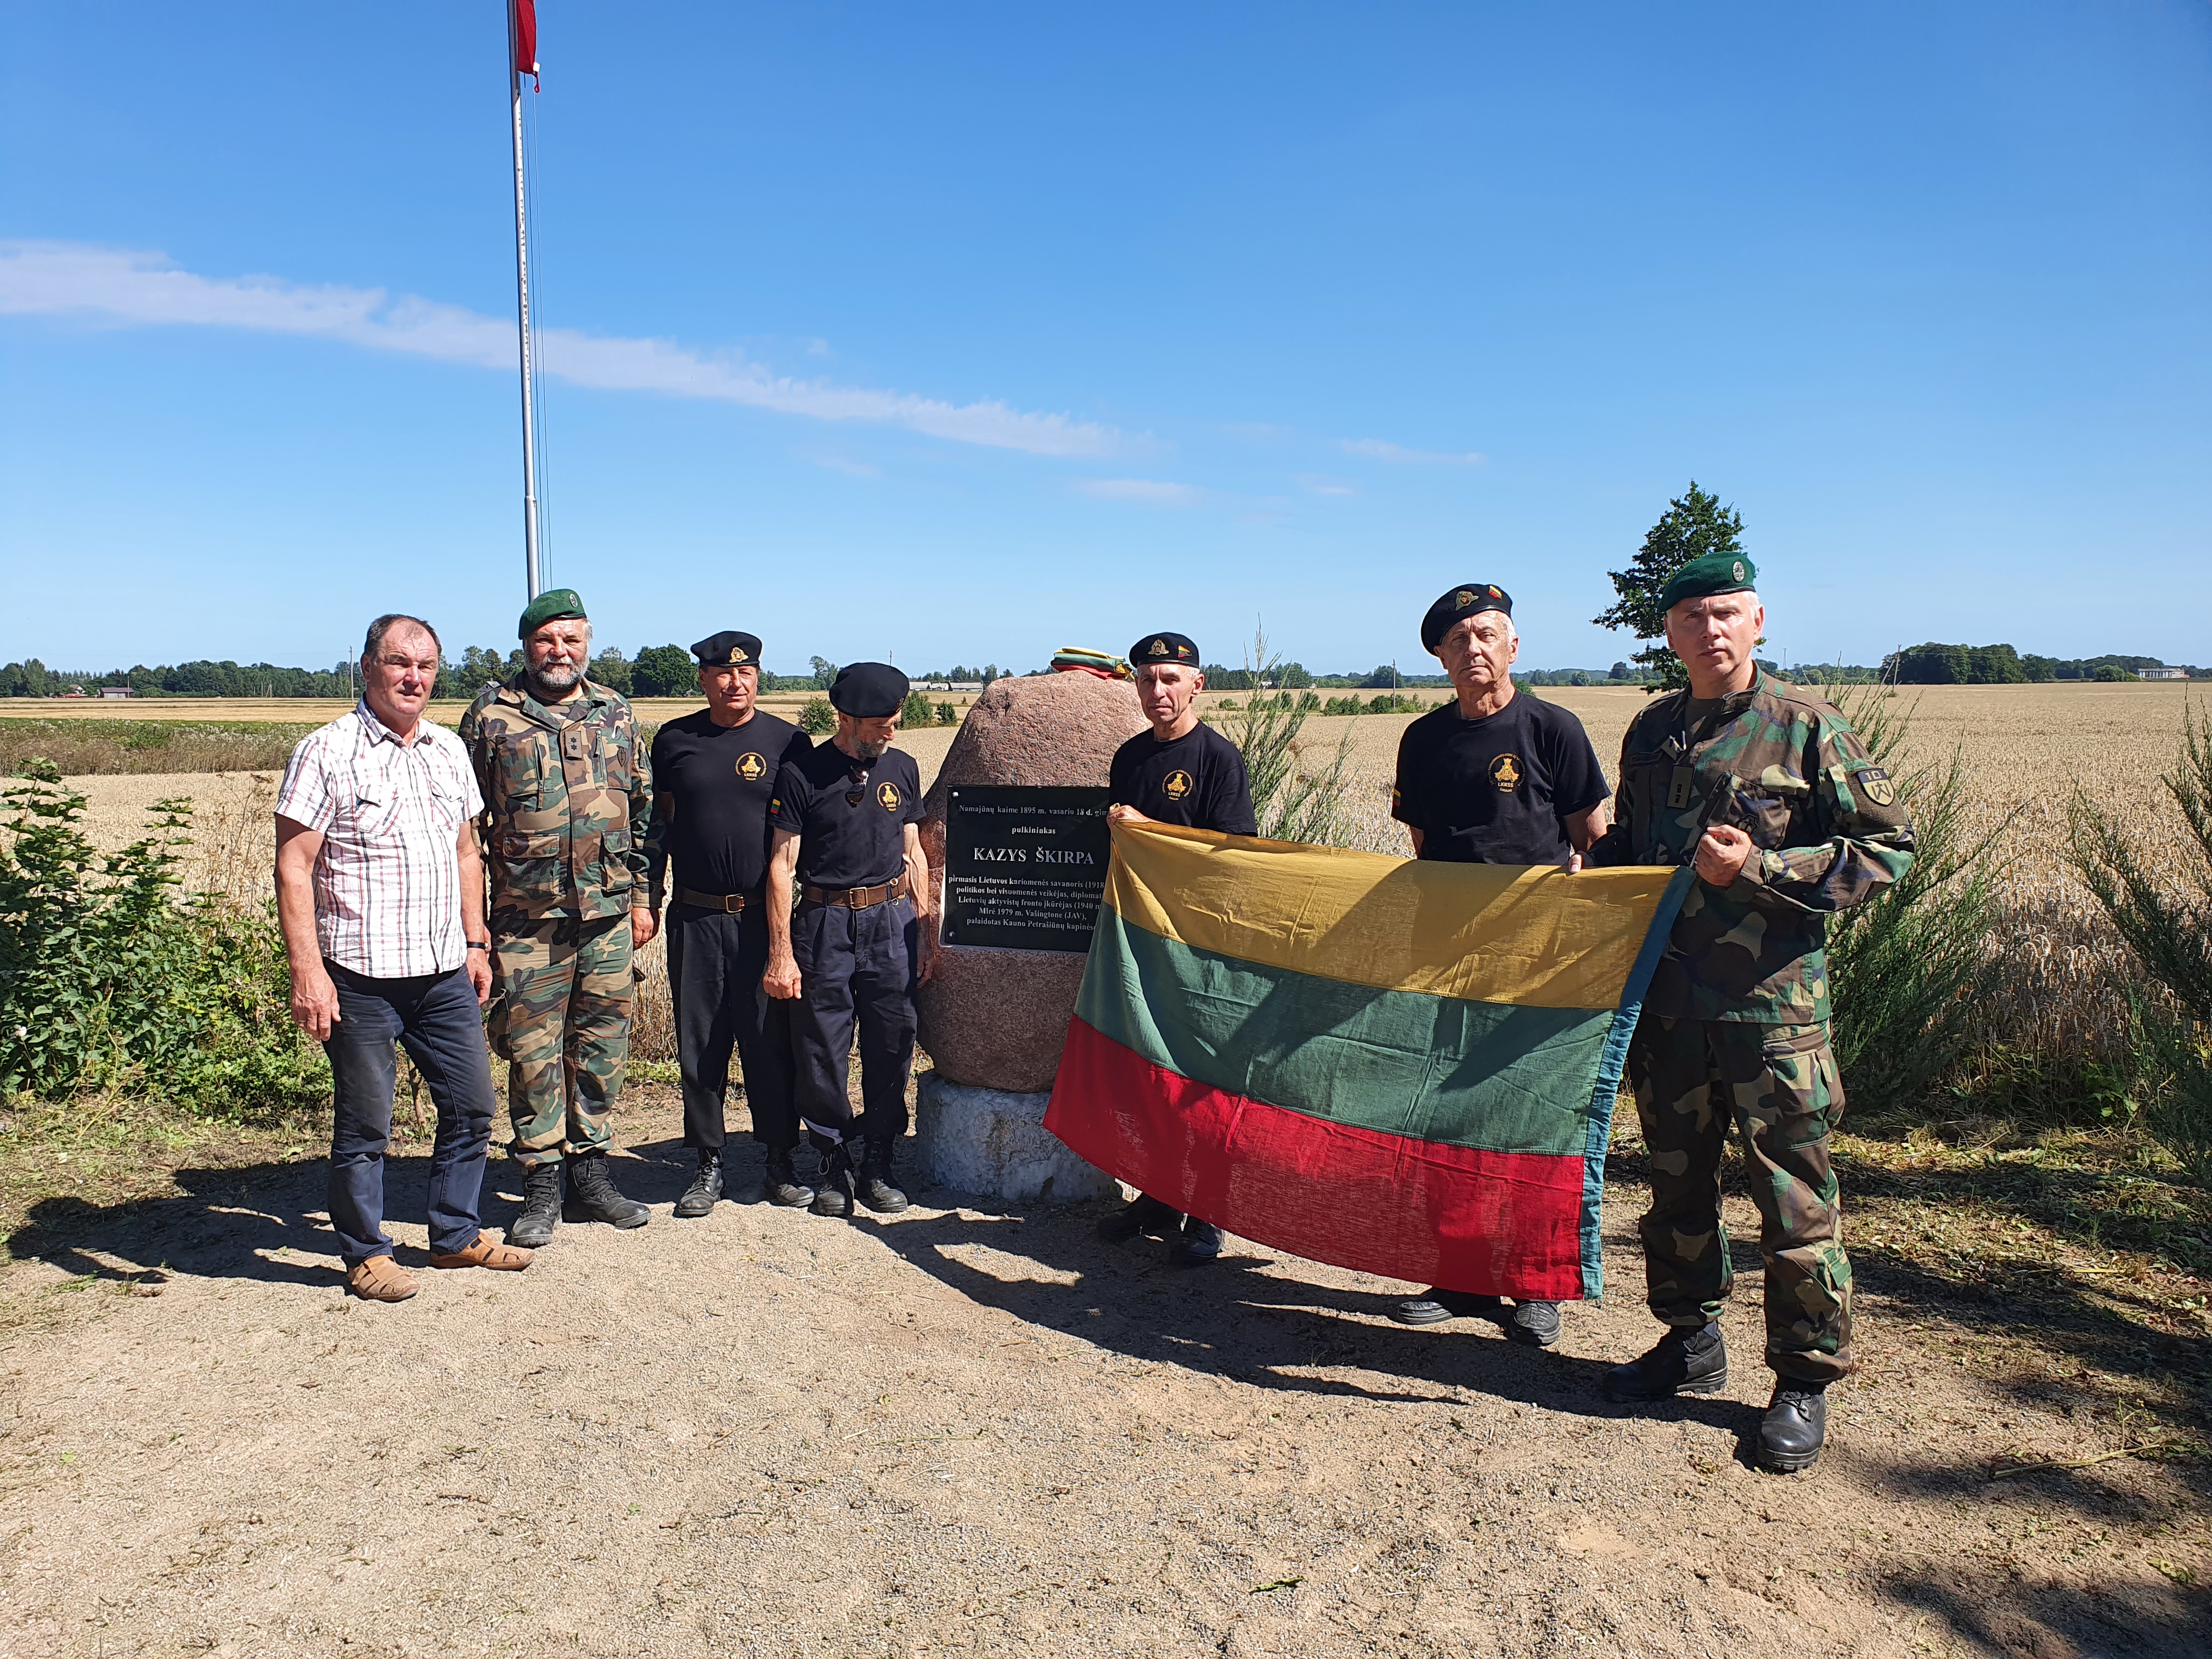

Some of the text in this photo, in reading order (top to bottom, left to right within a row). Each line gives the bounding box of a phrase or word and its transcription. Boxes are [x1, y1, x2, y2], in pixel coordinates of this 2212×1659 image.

[1865, 770, 1882, 780] 10
[959, 804, 995, 815] Namajūnų
[997, 805, 1018, 814] kaime
[1094, 809, 1108, 817] gim
[1012, 826, 1056, 834] pulkininkas
[973, 846, 1094, 865] KAZYS ŠKIRPA
[948, 874, 977, 884] pirmasis
[978, 876, 1008, 884] Lietuvos
[1009, 878, 1048, 887] kariomenės
[1085, 881, 1104, 889] (1918
[956, 885, 985, 894] politikos
[1039, 890, 1069, 899] veikėjas,
[1070, 891, 1102, 900] diplomat
[958, 896, 986, 905] Lietuvių
[988, 898, 1019, 907] aktyvistų
[1044, 899, 1073, 910] įkūrėjas
[1074, 901, 1093, 910] (1940
[1025, 909, 1063, 919] Vašingtone
[1064, 911, 1087, 921] (JAV),
[967, 917, 1001, 926] palaidotas
[1003, 918, 1026, 927] Kauno
[1028, 920, 1065, 930] Petrašiūnų
